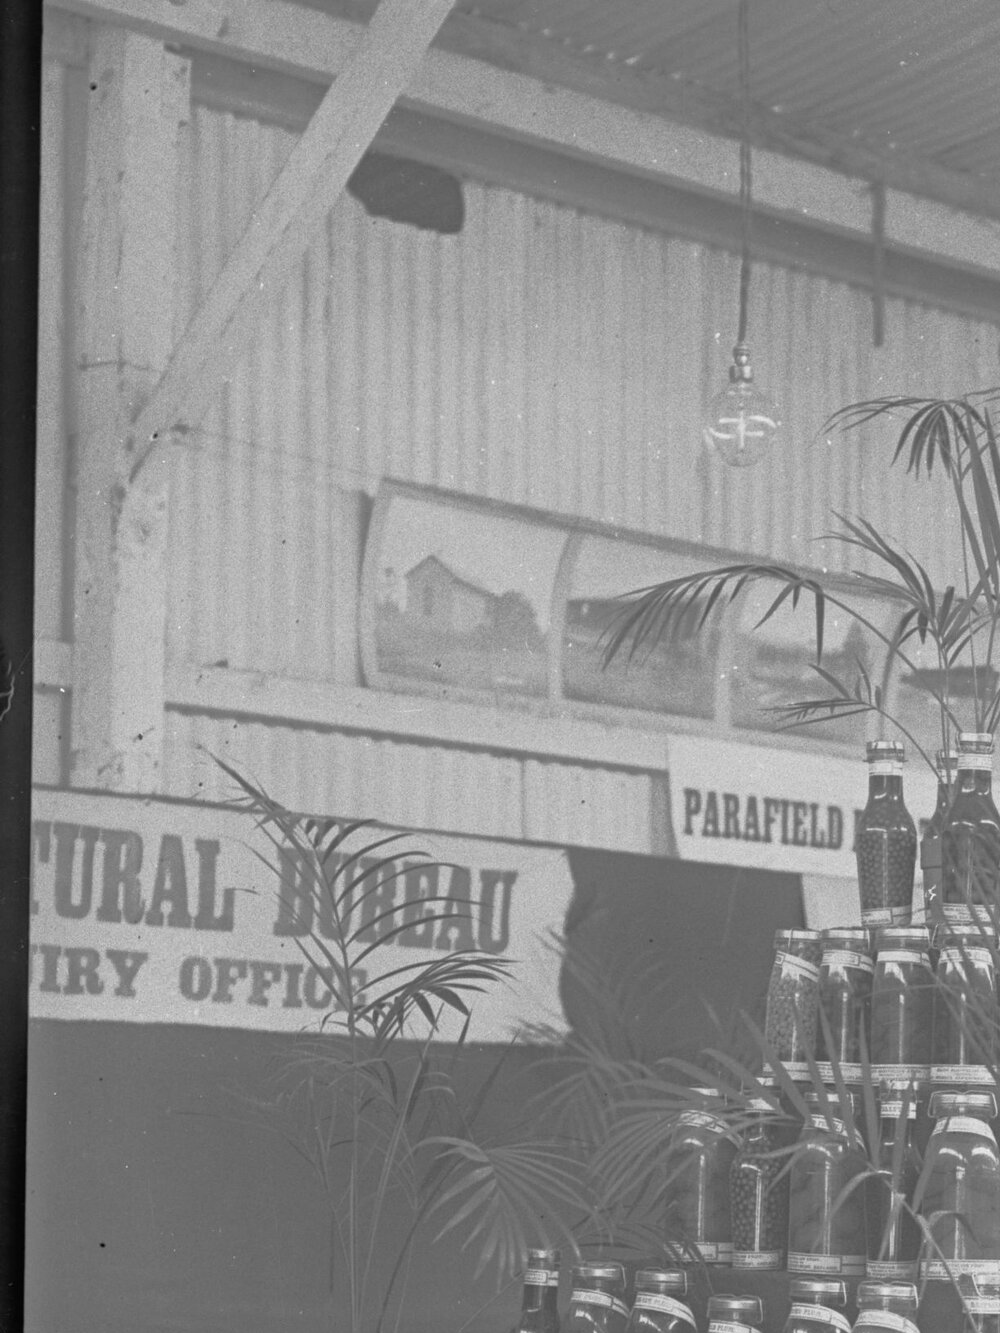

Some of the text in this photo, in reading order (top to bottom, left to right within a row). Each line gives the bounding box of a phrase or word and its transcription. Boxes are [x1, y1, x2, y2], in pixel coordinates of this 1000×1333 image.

[683, 787, 843, 850] PARAFIELD
[273, 848, 518, 953] BUREAU
[31, 943, 149, 997] IRY
